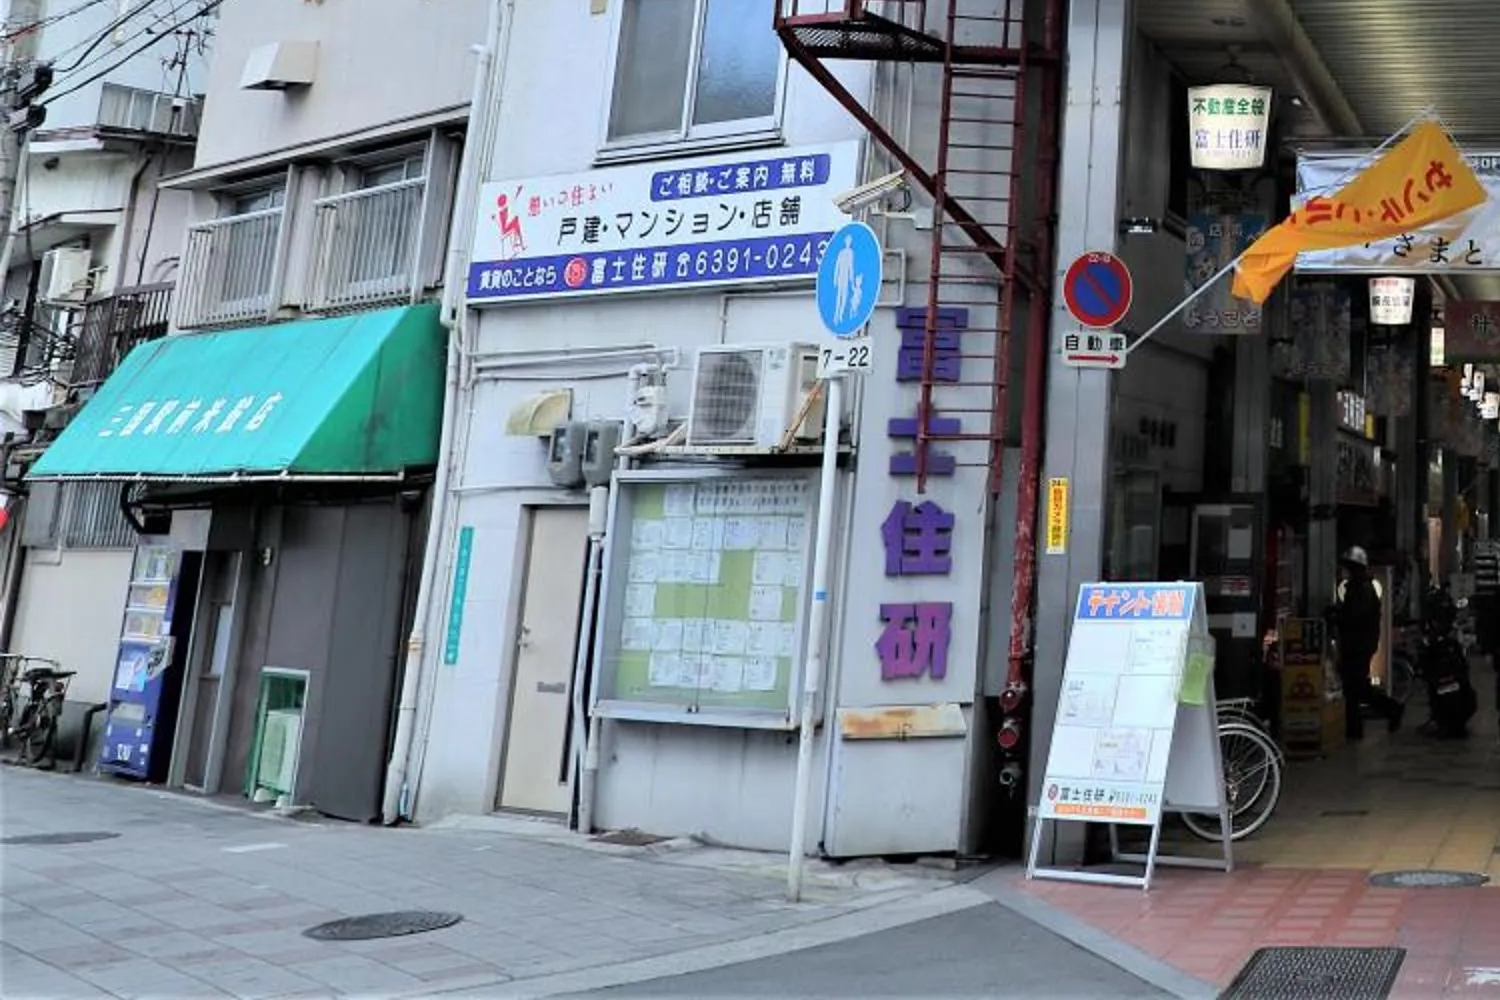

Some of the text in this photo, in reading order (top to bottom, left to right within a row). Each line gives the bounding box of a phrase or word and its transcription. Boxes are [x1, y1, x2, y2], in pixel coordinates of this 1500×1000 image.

[658, 158, 815, 197] ご相談・ご案内 無料
[557, 195, 802, 246] 戸建・マンション・店舗
[1364, 233, 1483, 265] さまと
[590, 251, 669, 285] 富士住研
[823, 343, 869, 368] 7-22
[1066, 335, 1124, 351] 自動車
[874, 307, 969, 681] 富士住研
